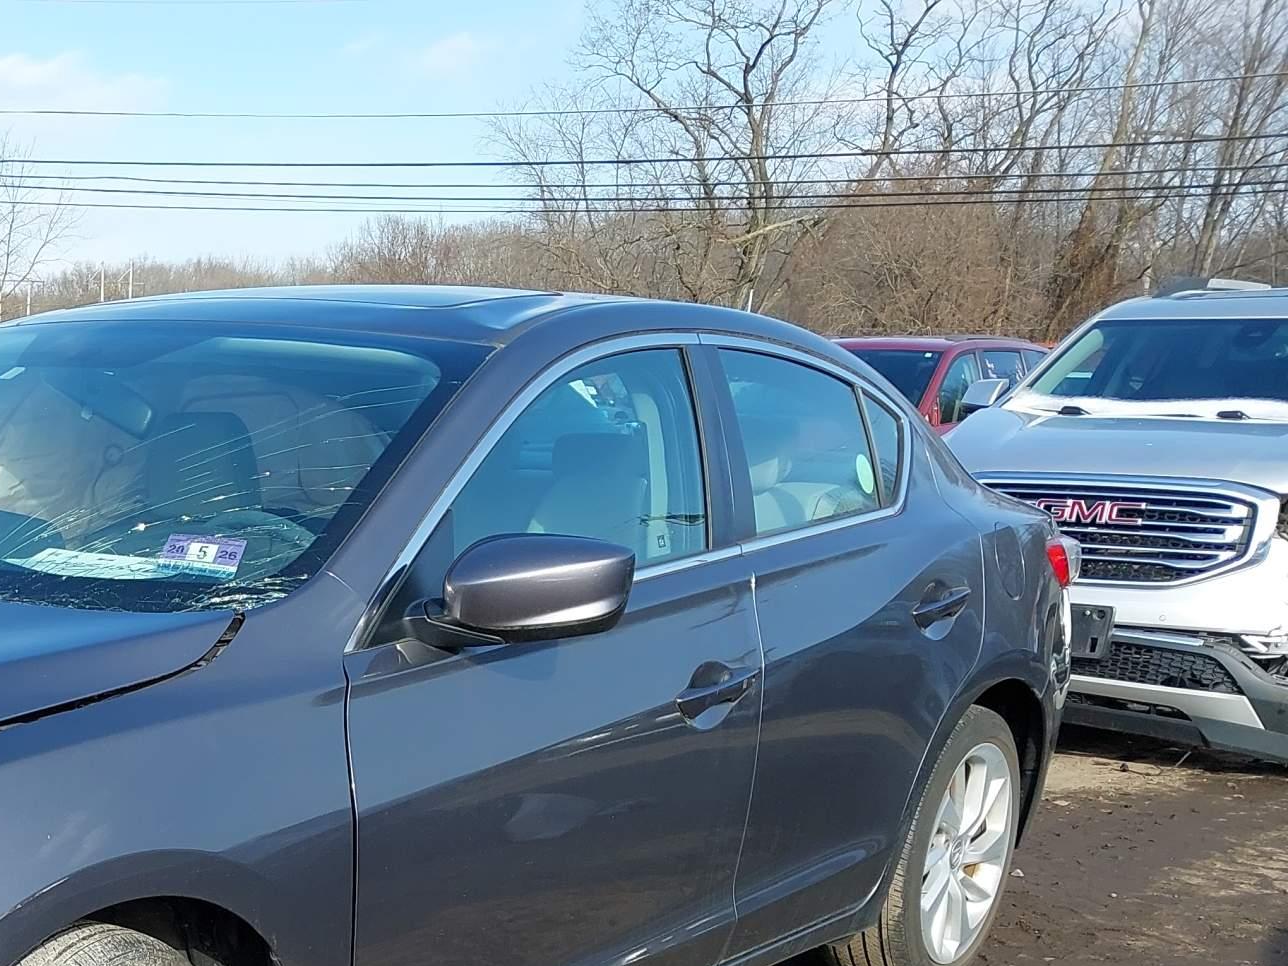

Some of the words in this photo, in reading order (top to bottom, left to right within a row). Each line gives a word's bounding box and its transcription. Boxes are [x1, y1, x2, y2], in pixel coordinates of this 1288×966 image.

[1035, 498, 1146, 526] GMC
[196, 545, 209, 560] 5
[218, 550, 239, 561] 26
